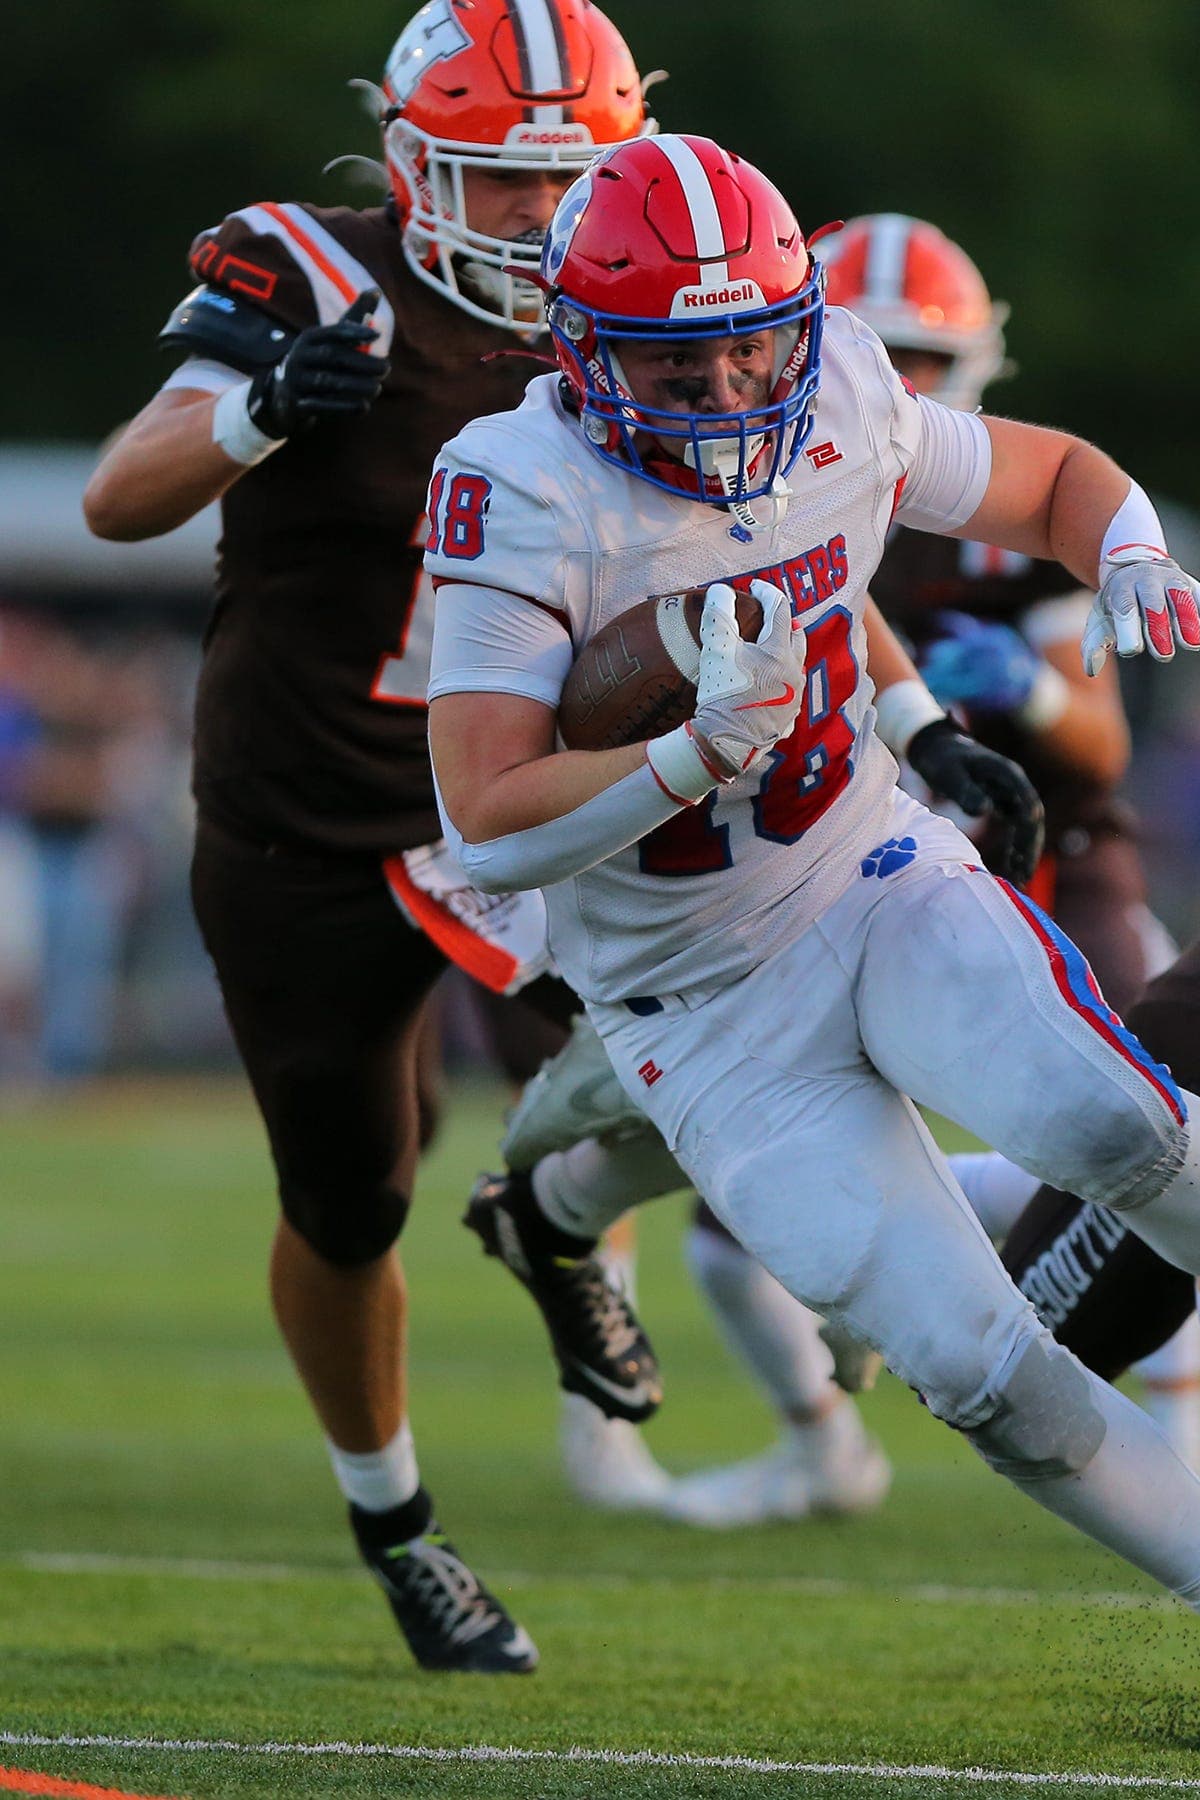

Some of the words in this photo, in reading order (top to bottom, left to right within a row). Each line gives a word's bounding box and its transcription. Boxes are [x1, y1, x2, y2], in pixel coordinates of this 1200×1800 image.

[684, 284, 754, 307] Riddell
[425, 467, 493, 561] 18
[702, 532, 849, 618] ERS
[1020, 1200, 1126, 1333] LLDOG
